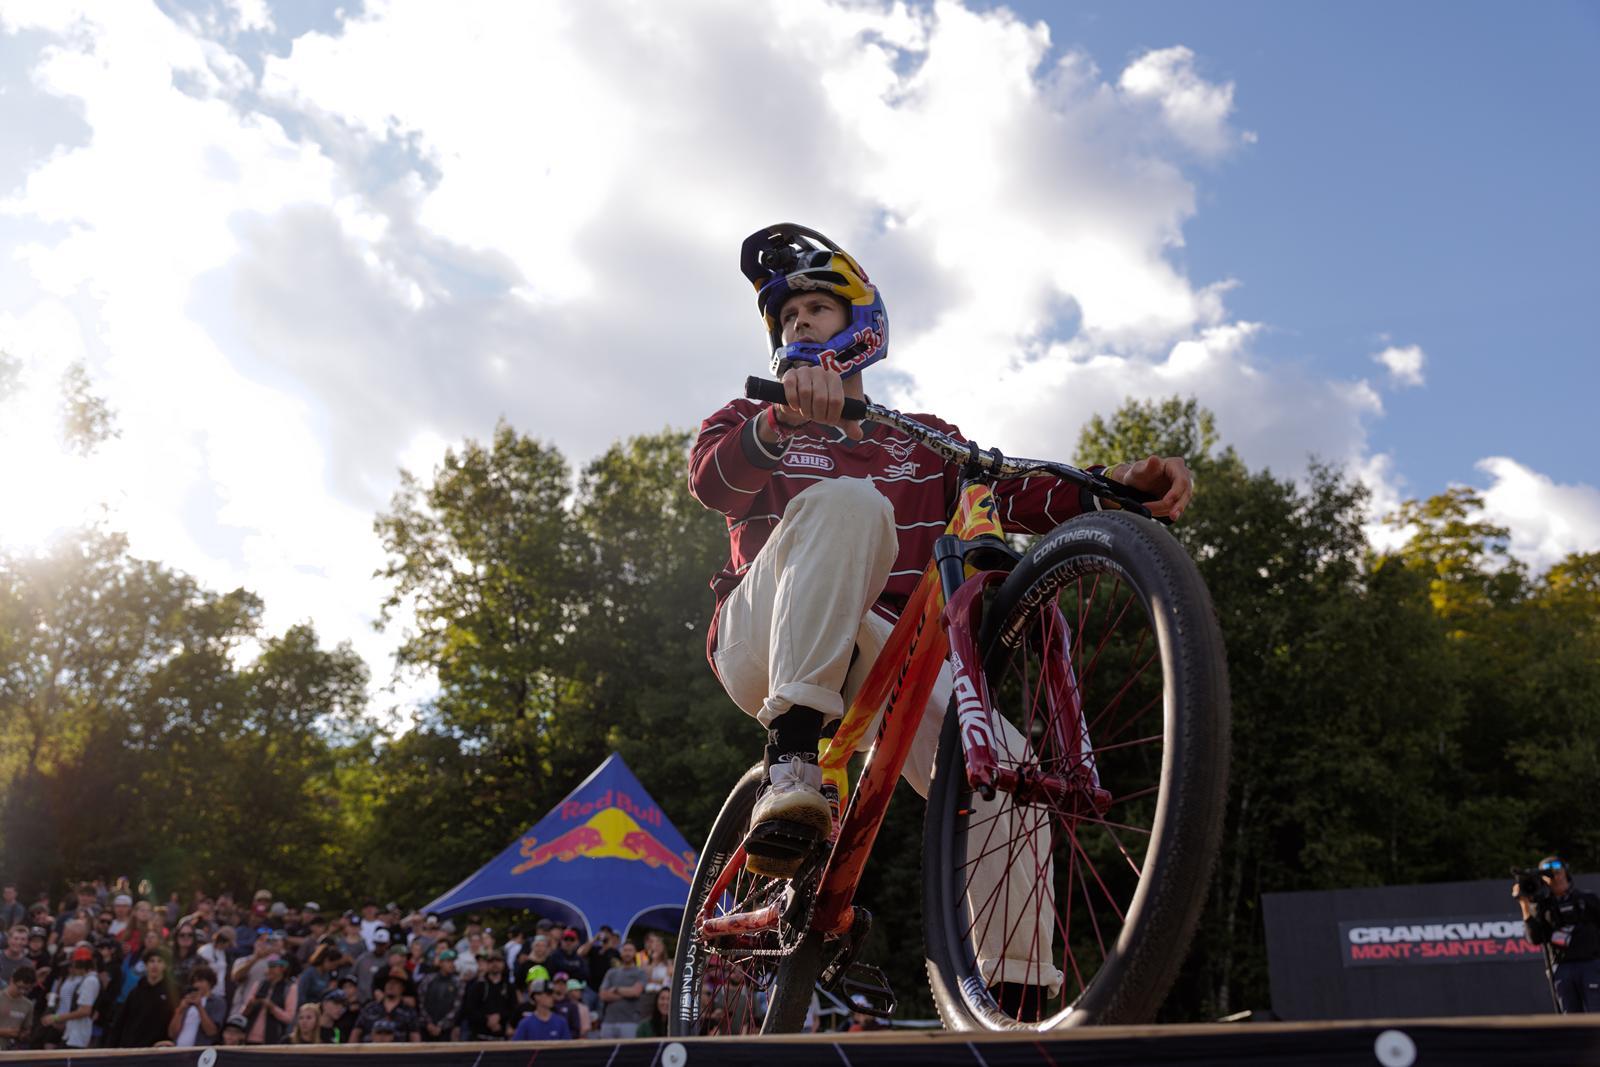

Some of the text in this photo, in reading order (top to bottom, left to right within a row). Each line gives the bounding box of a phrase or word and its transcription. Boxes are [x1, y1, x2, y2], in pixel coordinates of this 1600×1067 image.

[788, 454, 829, 468] ABUS
[1033, 529, 1112, 564] CONTINENTAL
[561, 789, 662, 827] Red Bull
[1349, 920, 1526, 944] CRANKWOR
[1351, 939, 1543, 960] MONT-SAINTE-AN
